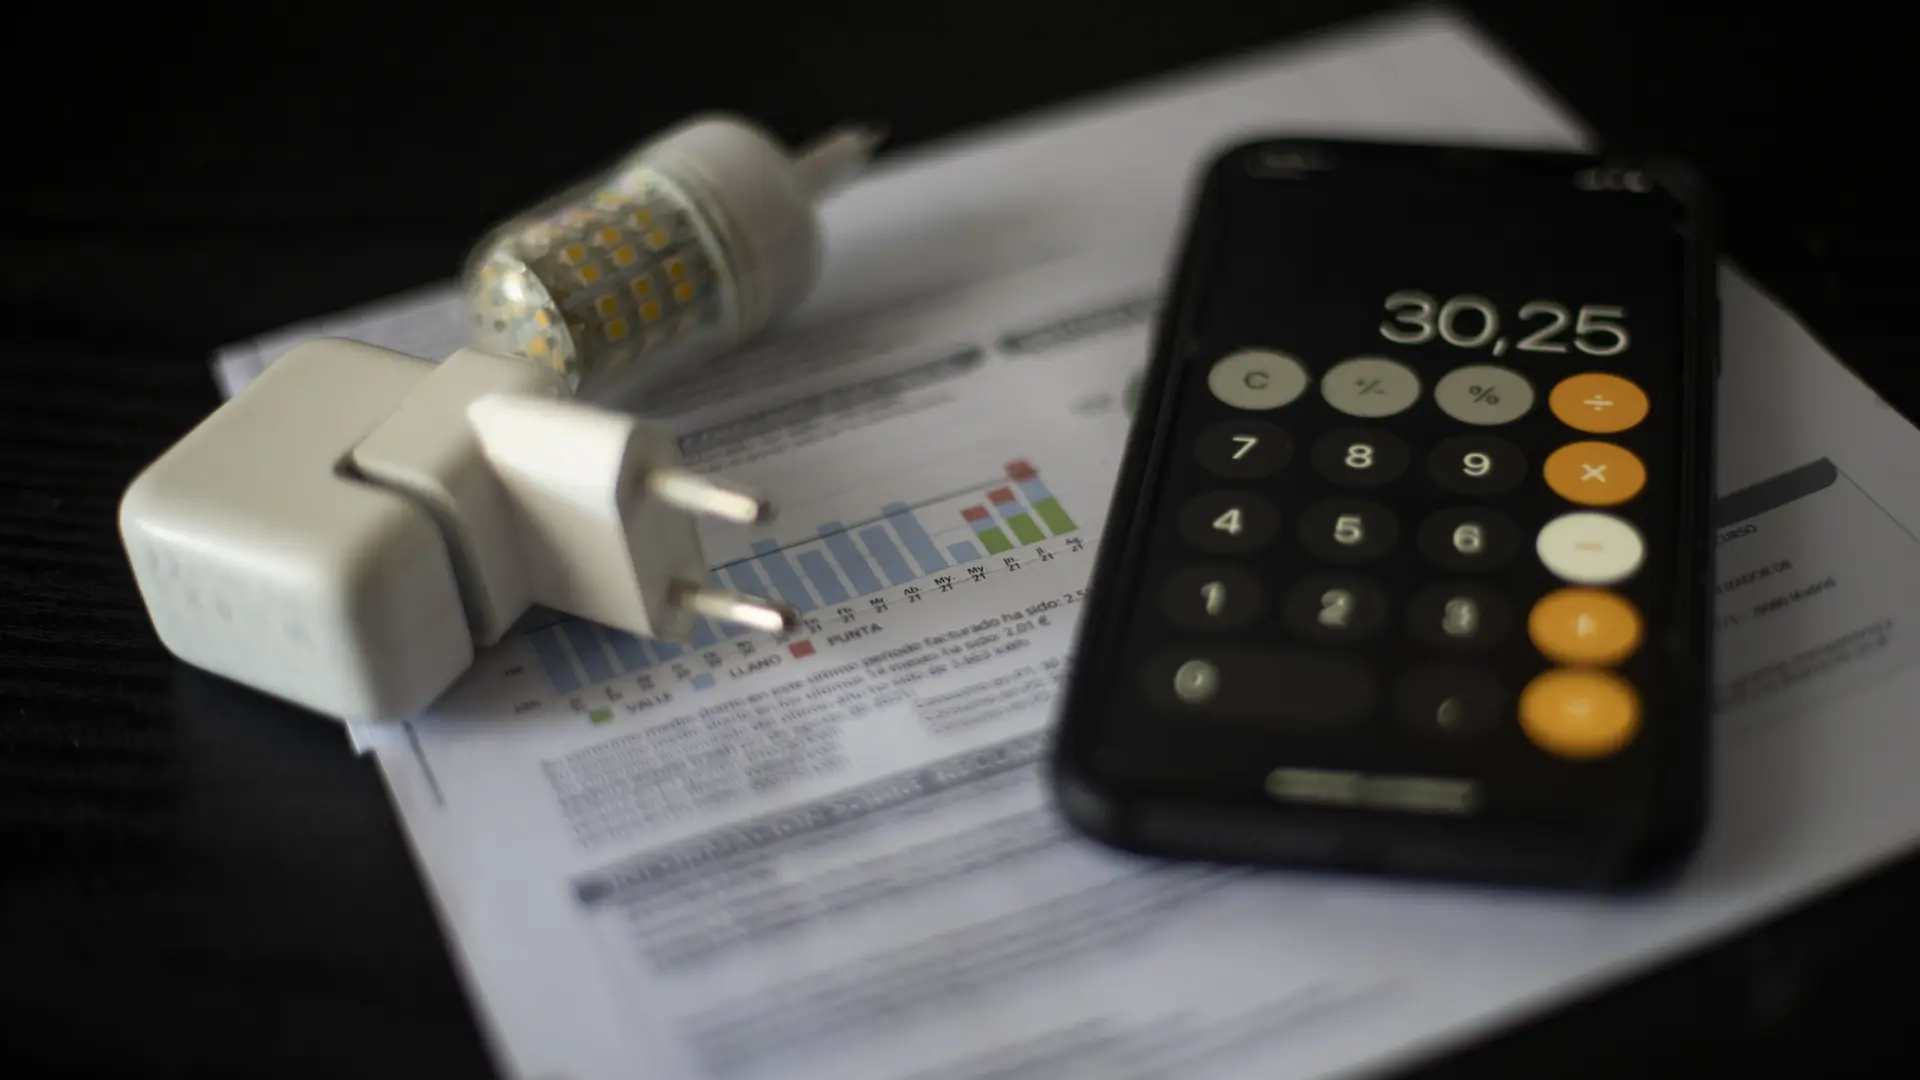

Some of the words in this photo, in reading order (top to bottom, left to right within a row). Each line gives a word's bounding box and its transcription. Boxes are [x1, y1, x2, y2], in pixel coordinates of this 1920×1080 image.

[1379, 289, 1632, 358] 30,25
[1243, 371, 1269, 391] C
[1231, 435, 1260, 460] 7
[1344, 443, 1376, 470] 8
[1461, 452, 1492, 478] 9
[1211, 508, 1243, 537] 4
[1332, 513, 1365, 546] 5
[1072, 543, 1083, 552] 21
[1451, 523, 1485, 555] 6
[1009, 563, 1021, 572] 21
[1042, 553, 1054, 562] 21
[940, 583, 953, 592] 21
[972, 573, 987, 582] 21
[875, 604, 889, 613] 21
[909, 594, 922, 603] 21
[1200, 580, 1227, 617] 1
[1317, 588, 1356, 628] 2
[923, 616, 1000, 647] facturado
[1001, 610, 1024, 624] ha
[1025, 598, 1064, 617] sido:
[1442, 596, 1480, 638] 3
[828, 622, 884, 646] PUNTA
[730, 653, 782, 678] LLANO
[1173, 657, 1220, 705] 0
